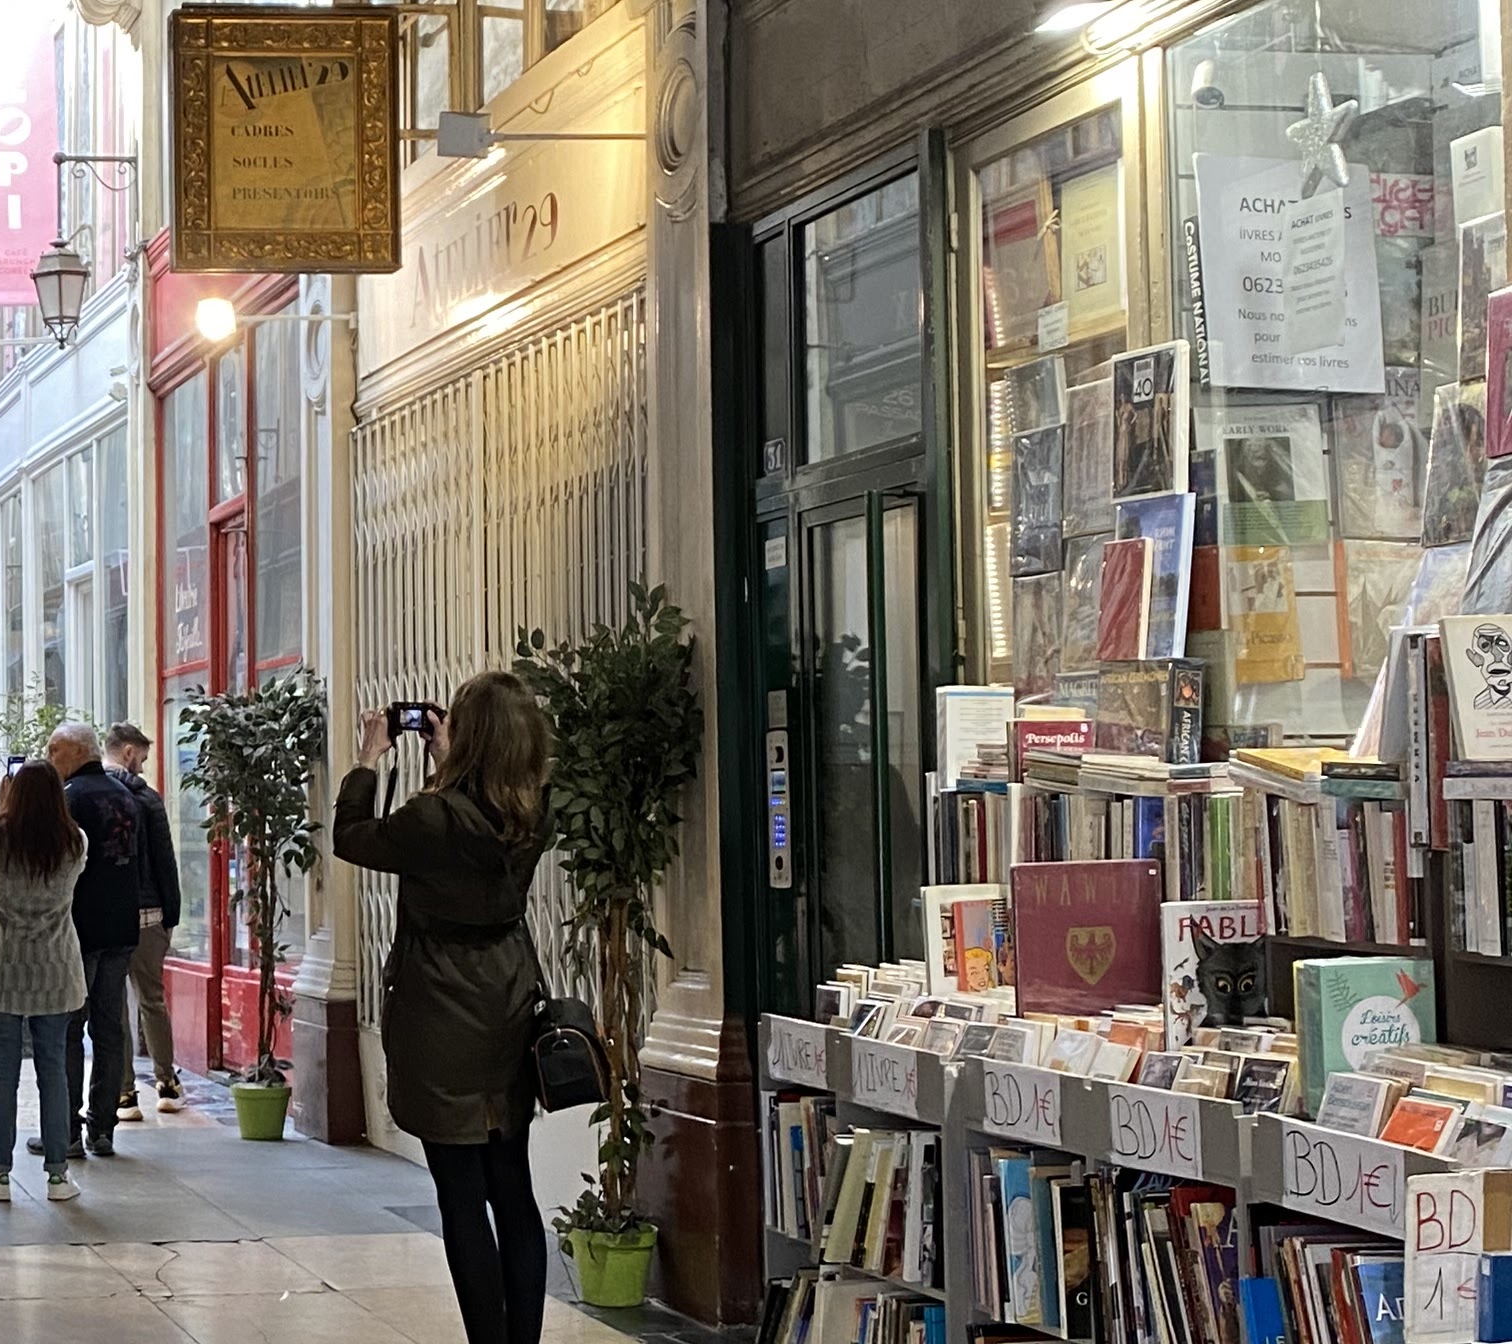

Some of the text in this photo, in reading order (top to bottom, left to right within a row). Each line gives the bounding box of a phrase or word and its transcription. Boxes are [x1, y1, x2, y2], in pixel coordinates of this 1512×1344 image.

[231, 124, 295, 138] CADRES
[232, 155, 294, 169] SOCLES
[1238, 308, 1267, 322] Nous
[1254, 332, 1281, 345] pour
[1251, 353, 1295, 366] estimer
[1319, 356, 1350, 369] livres
[767, 443, 782, 471] 31
[1025, 732, 1085, 752] Persepolis
[1359, 1008, 1401, 1025] Loisirs
[1351, 1022, 1410, 1047] créatifs
[985, 1071, 1022, 1126] BD
[1111, 1094, 1193, 1163] BD 1€
[1286, 1129, 1391, 1215] BD 1€
[1416, 1189, 1476, 1252] BD
